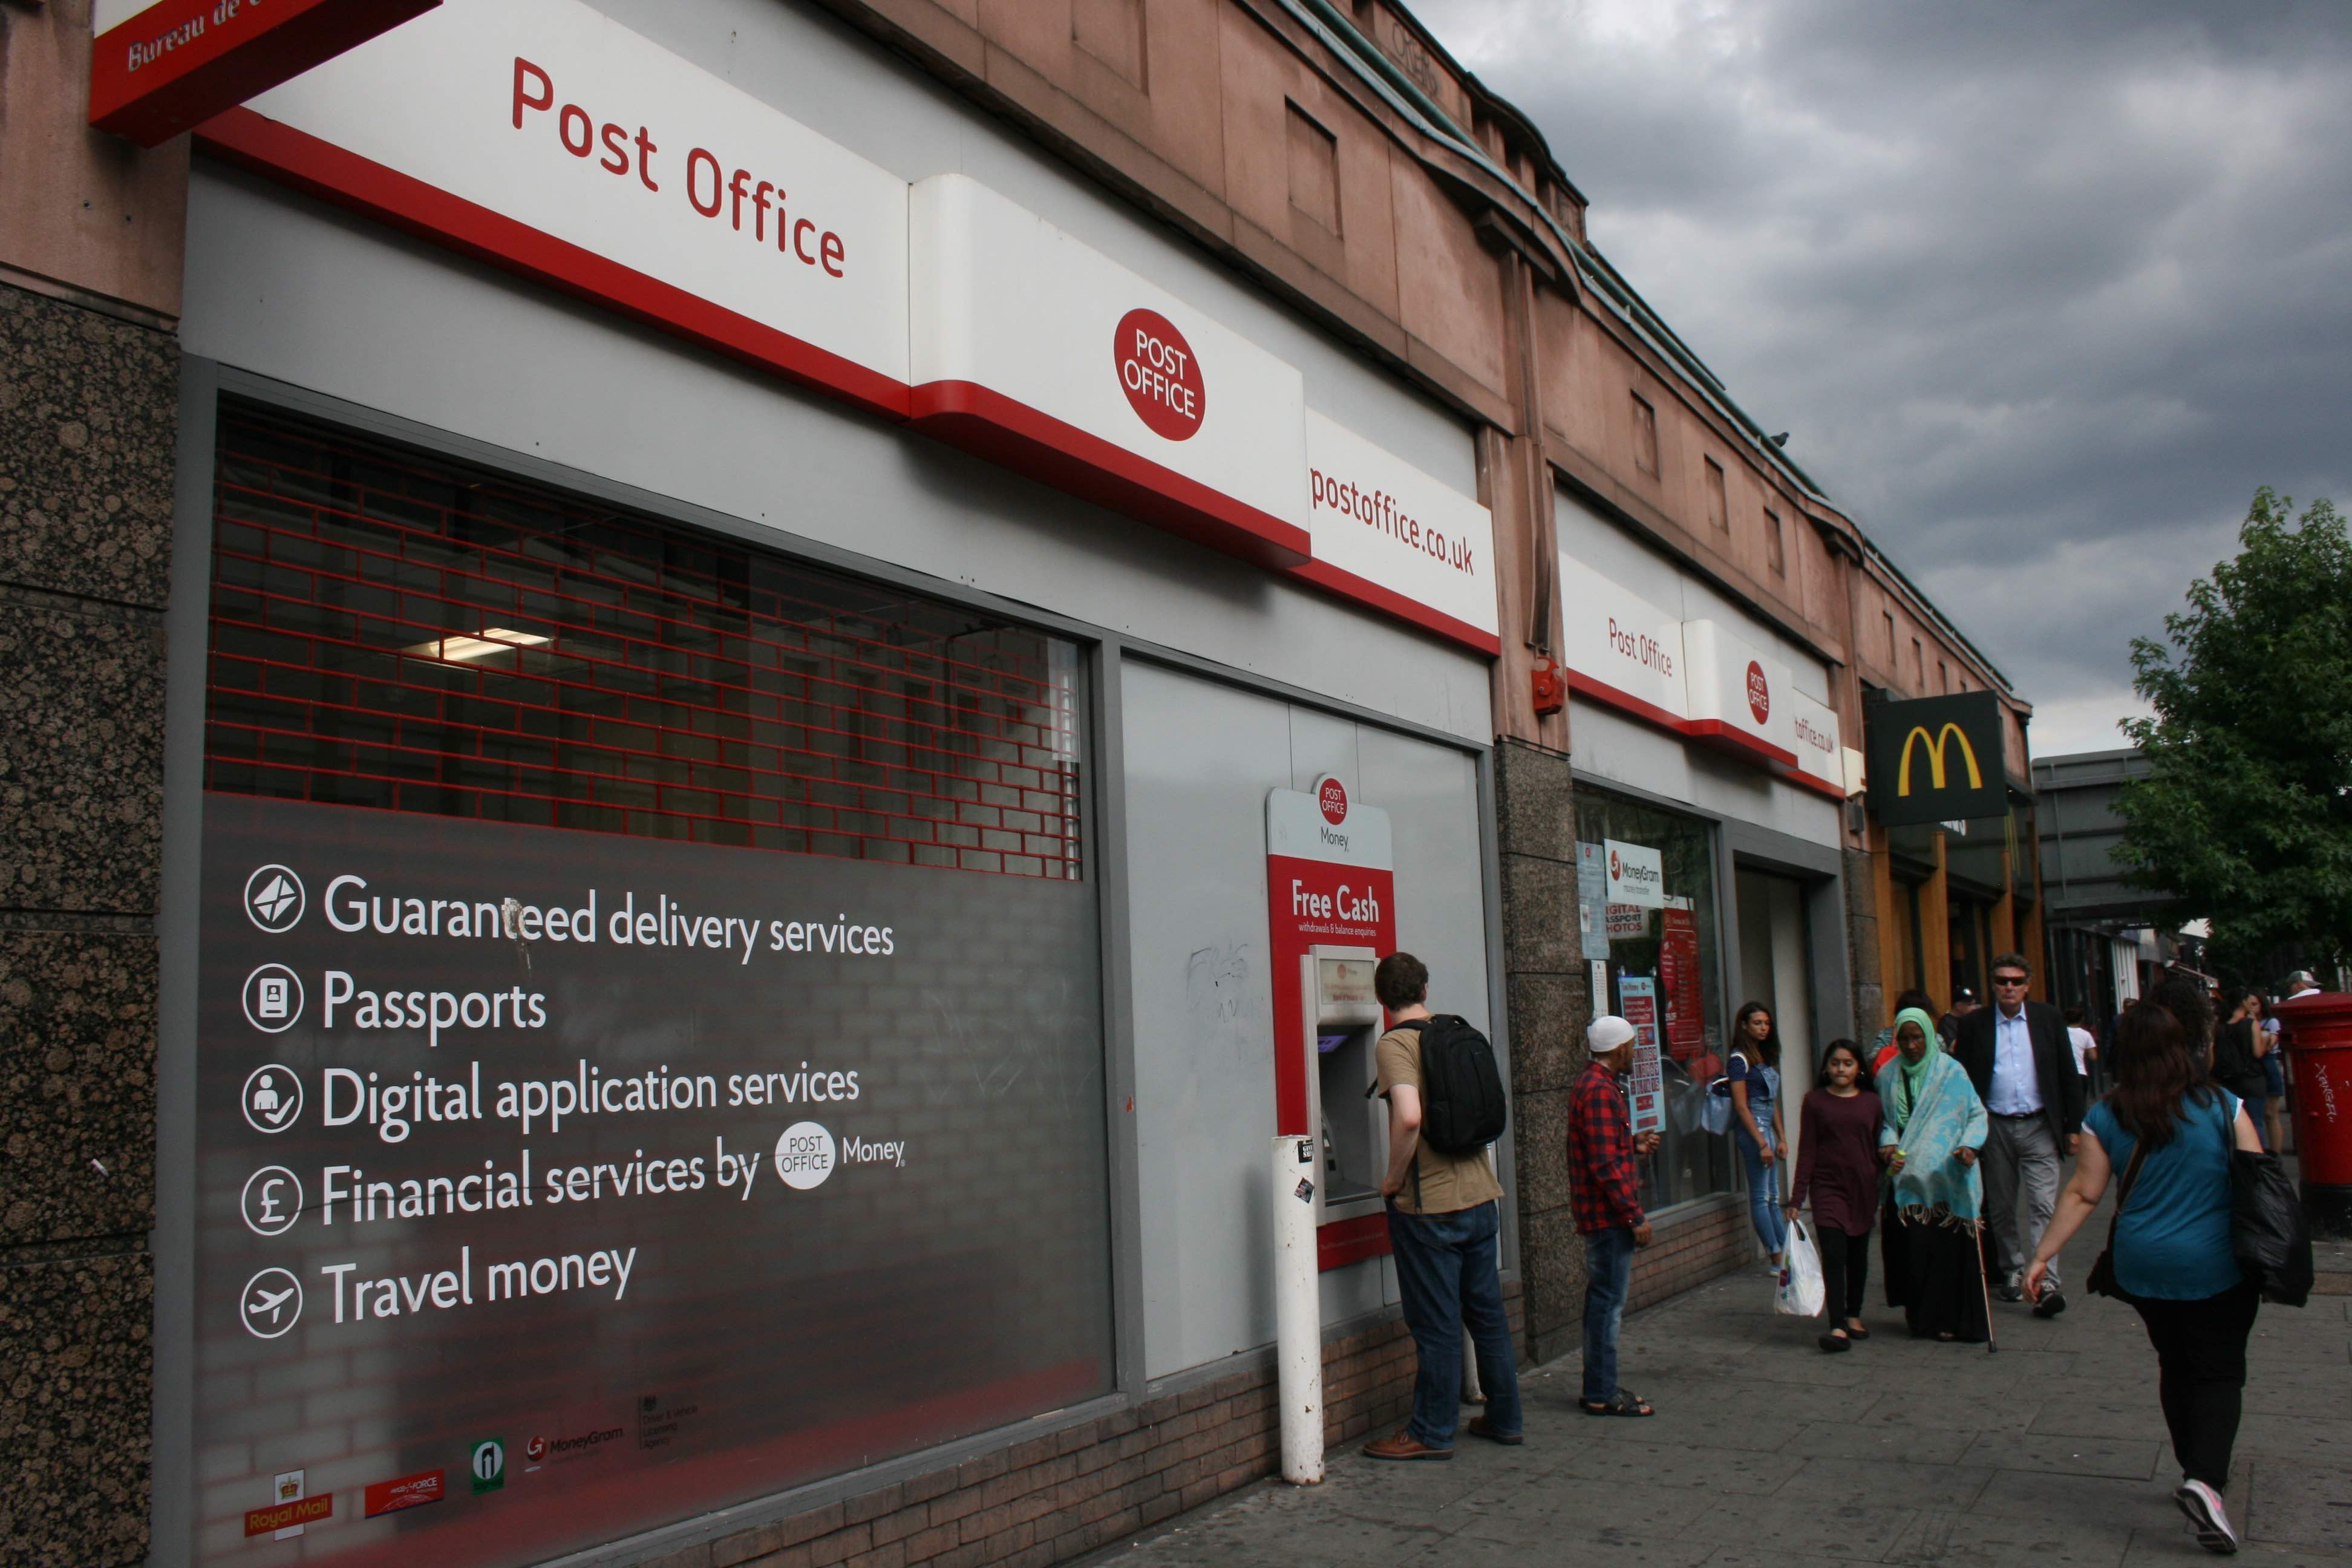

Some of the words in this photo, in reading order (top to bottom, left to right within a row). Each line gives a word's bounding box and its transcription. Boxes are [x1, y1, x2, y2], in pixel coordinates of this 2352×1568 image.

[128, 15, 204, 73] Bureau
[213, 0, 240, 25] de
[512, 56, 659, 192] Post
[687, 147, 844, 278] Office
[1136, 328, 1187, 380] POST
[1124, 359, 1196, 420] OFFICE
[1310, 468, 1474, 576] postoffice.co.uk
[1609, 617, 1636, 660] Post
[1640, 634, 1672, 678] Office
[1749, 688, 1768, 711] OFFICE
[1750, 672, 1765, 690] POST
[1322, 800, 1344, 814] OFFICE
[1325, 787, 1341, 800] POST
[1321, 826, 1348, 852] Money
[1622, 862, 1659, 883] MoneyGram
[325, 874, 596, 942] Guaranteed
[609, 891, 760, 965] delivery
[770, 913, 893, 956] services
[1292, 879, 1331, 918] Free
[1336, 884, 1379, 923] Cash
[1298, 921, 1329, 933] withdrawals
[1330, 923, 1334, 933] &
[1334, 923, 1354, 935] balance
[1354, 926, 1376, 939] enquiries
[324, 970, 546, 1047] Passports
[324, 1060, 482, 1143] Digital
[496, 1059, 717, 1135] application
[728, 1060, 860, 1106] services
[789, 1135, 823, 1154] POST
[843, 1135, 905, 1168] Money
[324, 1149, 532, 1226] Financial
[546, 1149, 705, 1203] services
[716, 1135, 760, 1201] by
[782, 1154, 828, 1174] OFFICE
[321, 1245, 473, 1324] Travel
[488, 1247, 636, 1301] money
[550, 1427, 624, 1454] MoneyGram
[250, 1506, 292, 1530] Royal
[296, 1498, 328, 1518] Mail
